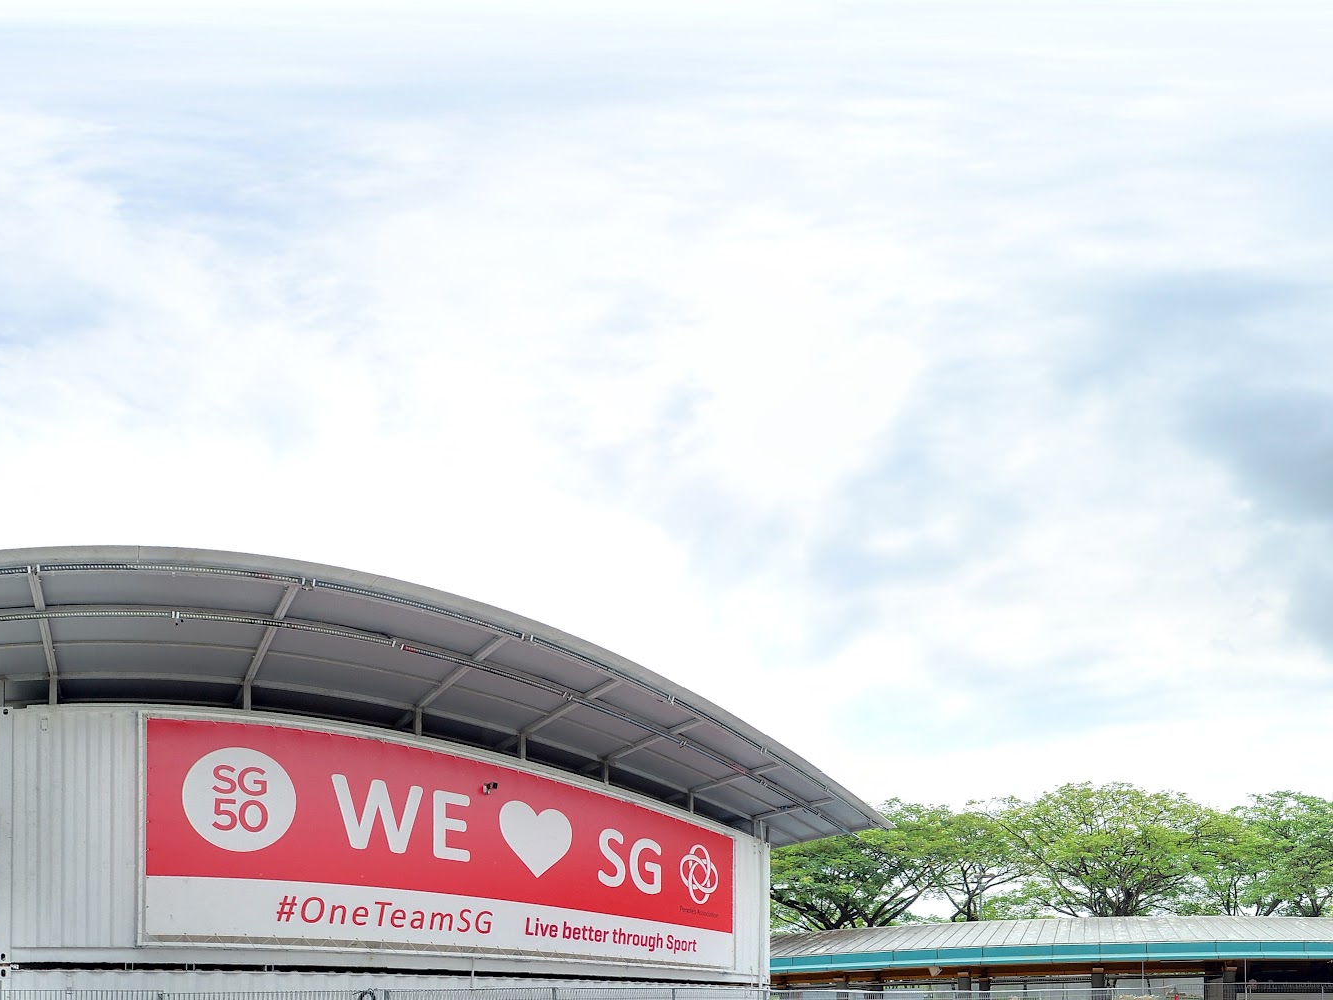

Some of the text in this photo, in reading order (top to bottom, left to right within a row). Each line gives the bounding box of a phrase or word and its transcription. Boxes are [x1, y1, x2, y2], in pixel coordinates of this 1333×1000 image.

[213, 765, 267, 797] SG
[213, 798, 269, 833] 50
[330, 774, 662, 895] WE SG
[276, 895, 493, 935] #OneTeamSG
[524, 916, 698, 954] Live better through Sport
